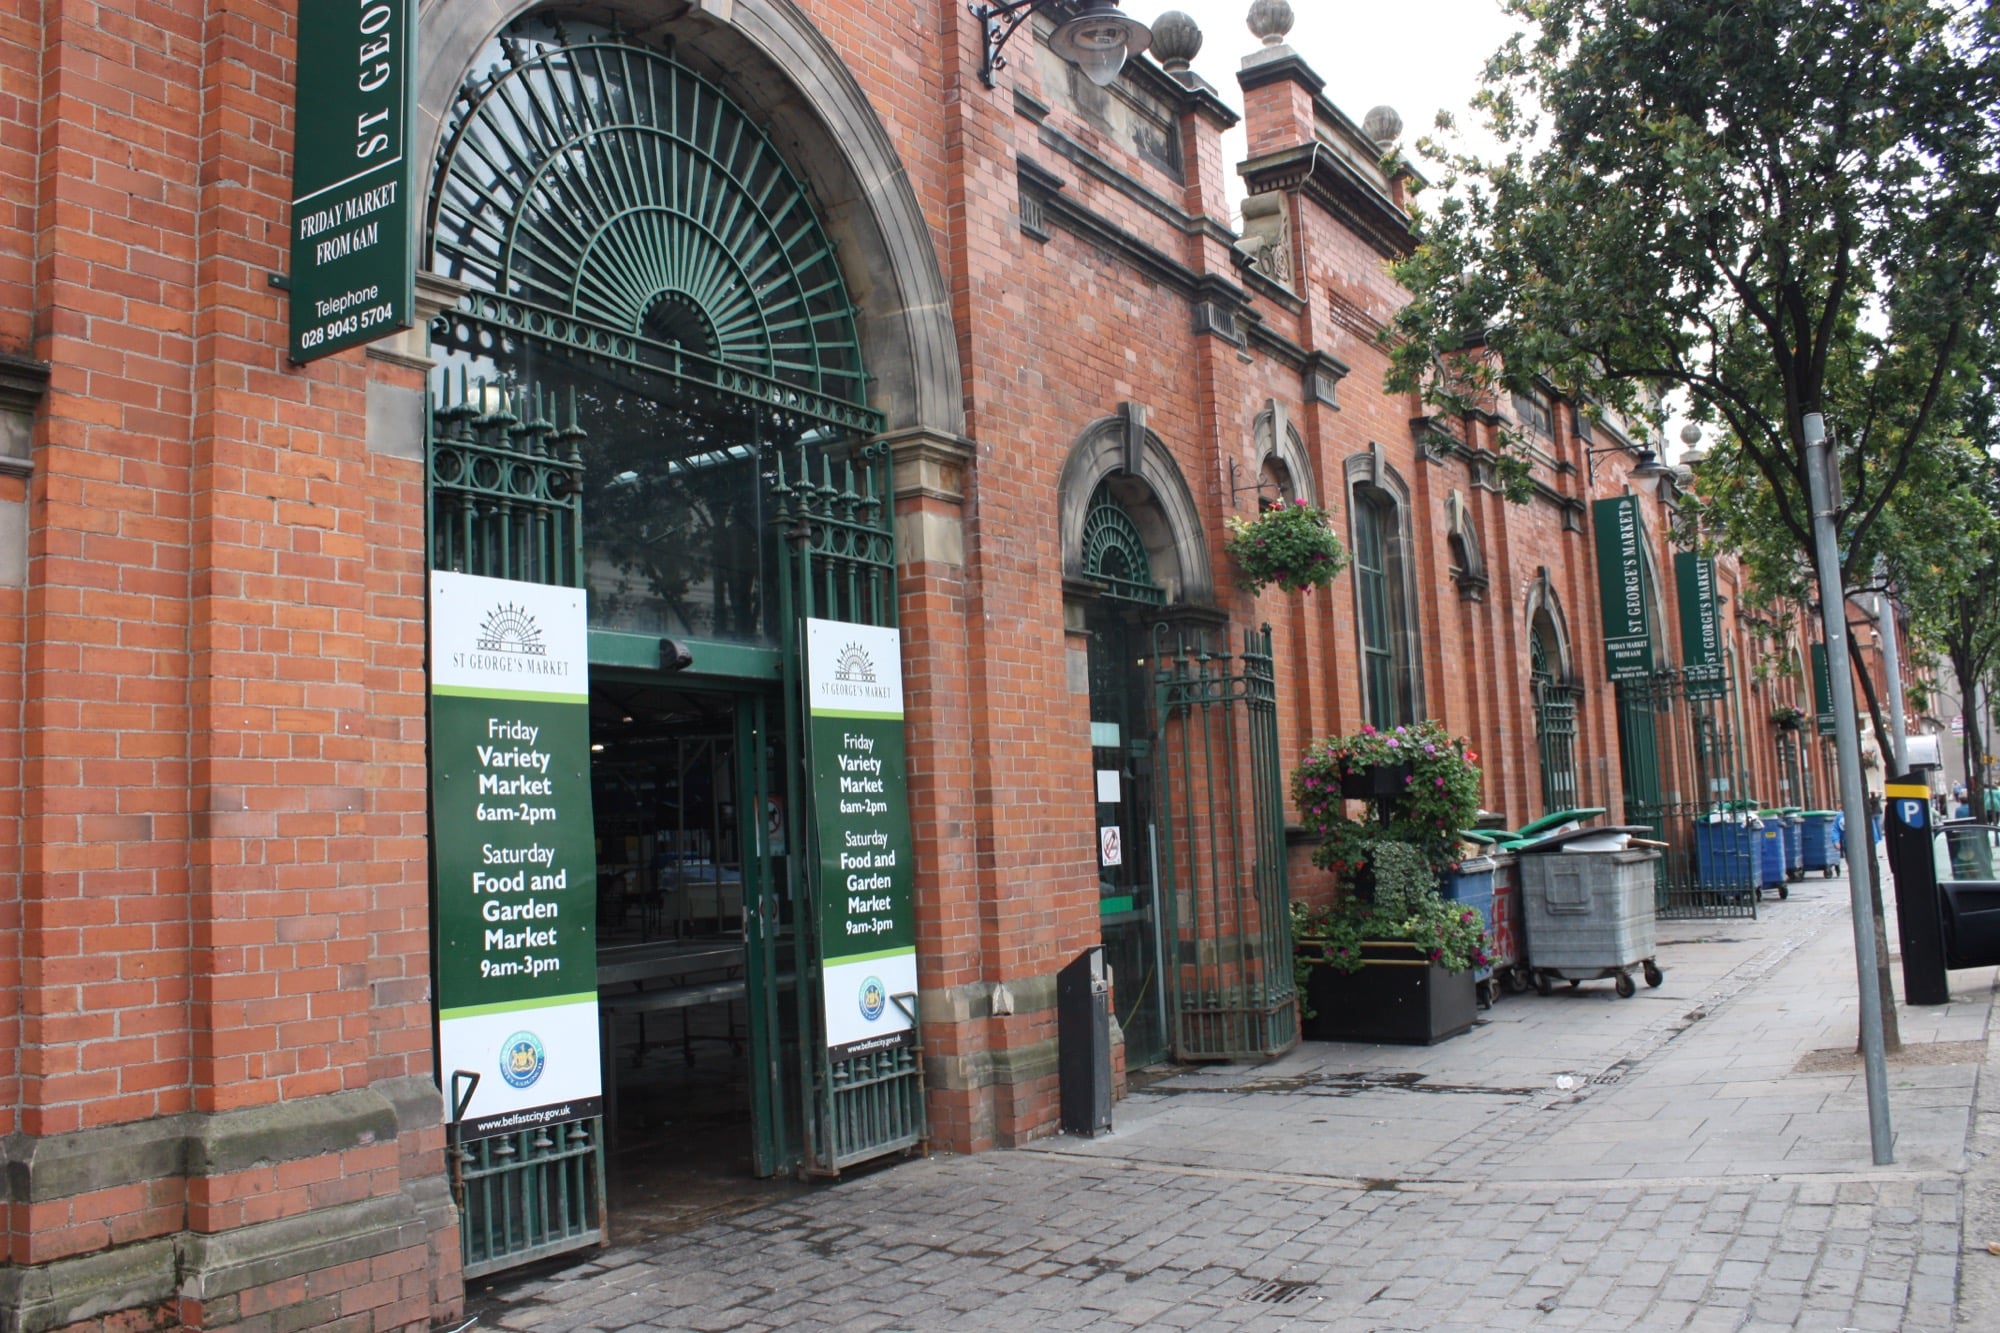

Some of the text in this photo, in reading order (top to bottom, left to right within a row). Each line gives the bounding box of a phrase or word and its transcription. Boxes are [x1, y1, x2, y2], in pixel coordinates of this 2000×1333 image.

[357, 108, 388, 158] ST
[300, 181, 397, 240] FRIDAY MARKET
[317, 221, 378, 265] FROM 6AM
[315, 285, 379, 319] Telephone
[302, 303, 392, 350] 028 9043 5704
[1618, 510, 1643, 633] ST GEORGE'S MARKET
[1696, 562, 1711, 600] MARKET
[1700, 602, 1716, 649] GEORGE'S
[453, 653, 569, 676] ST GEORGE'S MARKET
[821, 682, 891, 699] ST GEORGE'S MARKET
[488, 718, 539, 746] Friday
[844, 733, 874, 754] Friday
[476, 745, 551, 774] Variety
[837, 754, 882, 776] Variety
[478, 774, 552, 795] Market
[840, 776, 884, 793] Market
[476, 803, 556, 825] 6am-2pm
[840, 799, 887, 816] 6am-2pm
[1903, 801, 1920, 823] P
[845, 829, 888, 849] Saturday
[482, 842, 555, 868] Saturday
[840, 849, 896, 869] Food and
[472, 868, 567, 894] Food and
[846, 873, 891, 892] Garden
[482, 898, 558, 922] Garden
[848, 895, 891, 914] Market
[845, 917, 893, 935] 9am-3pm
[484, 926, 557, 951] Market
[480, 955, 560, 978] 9am-3pm
[478, 1104, 571, 1132] www.belfastcity.gov.uk
